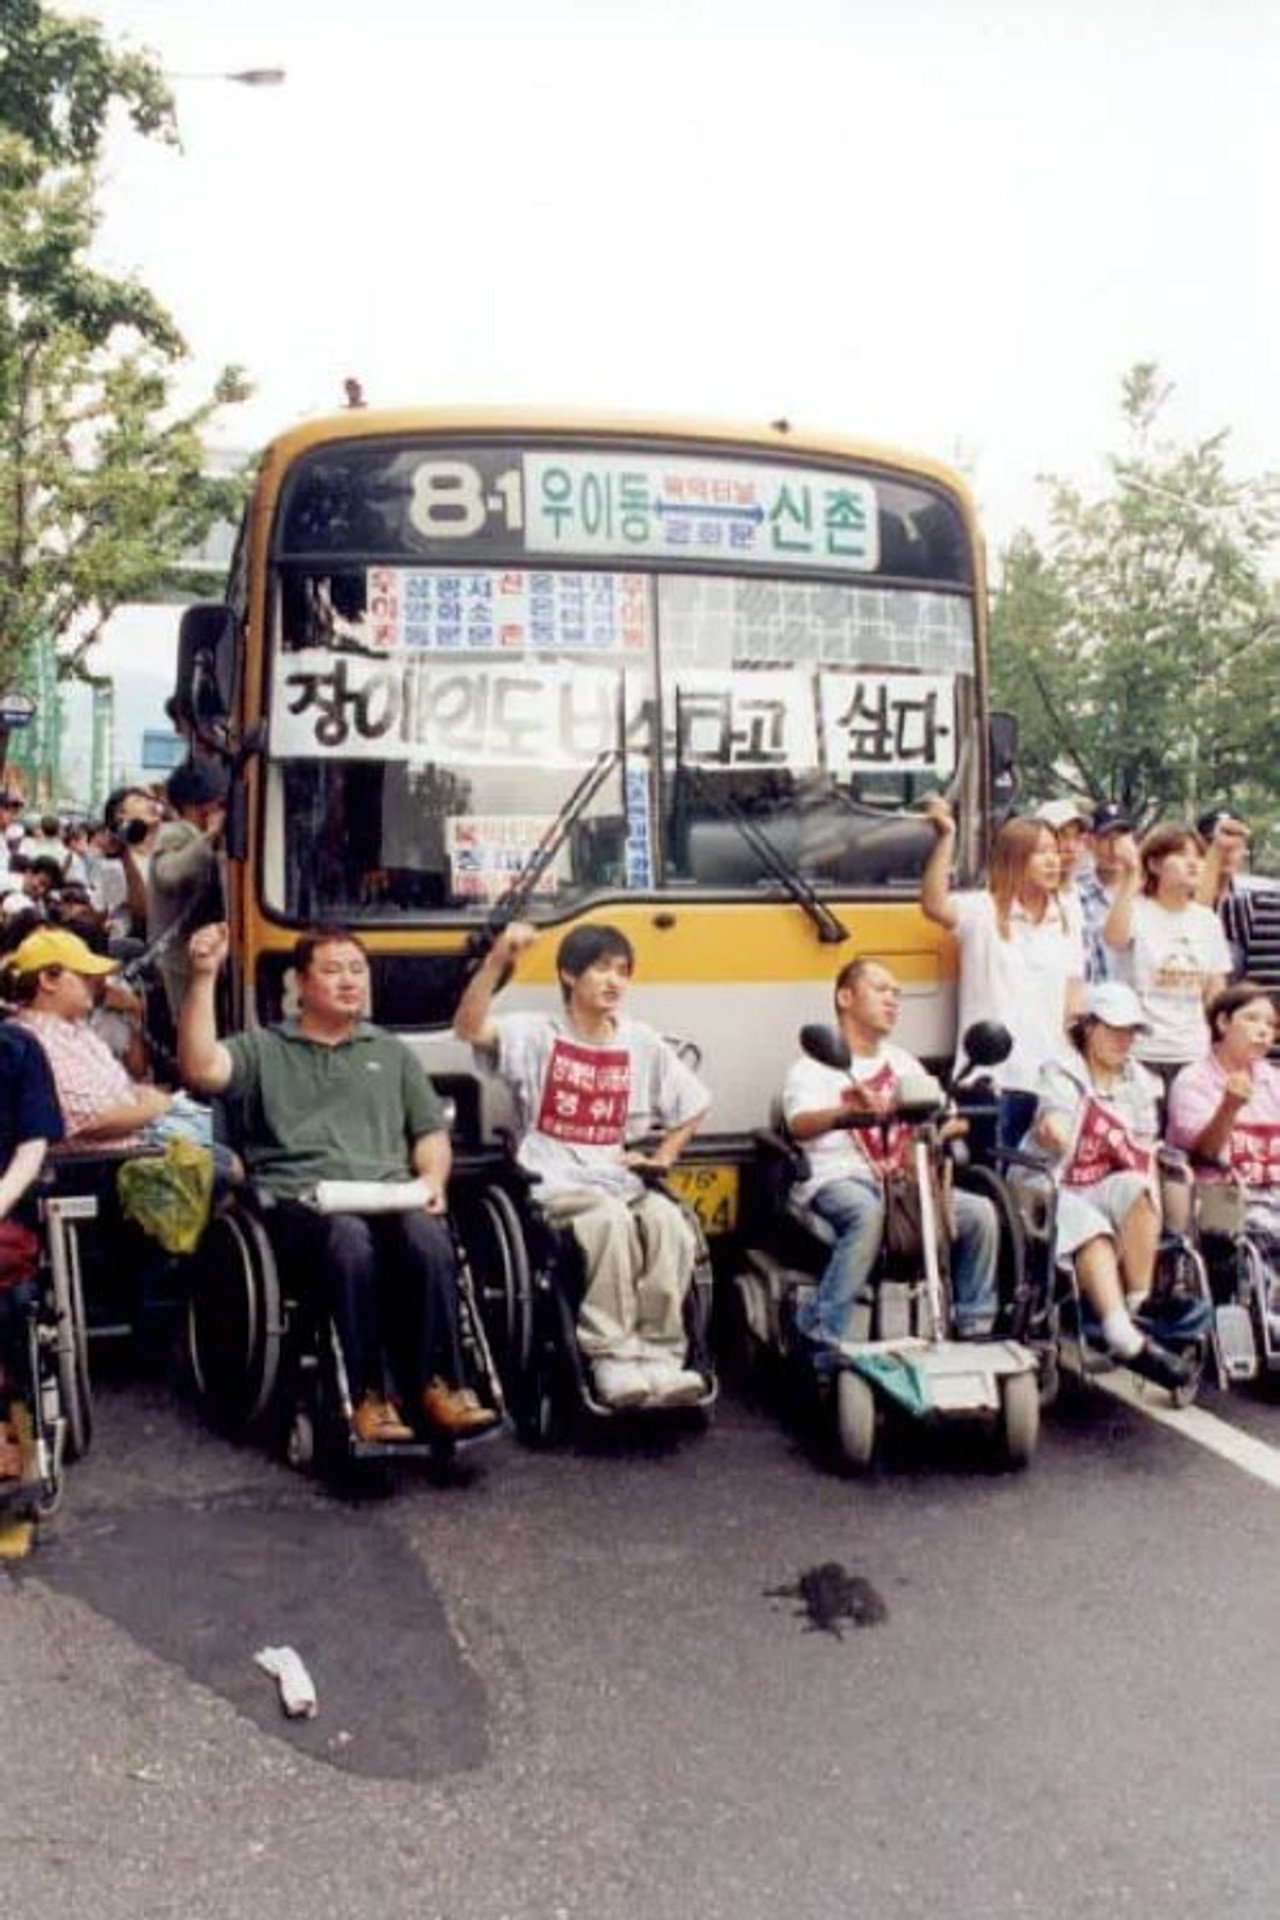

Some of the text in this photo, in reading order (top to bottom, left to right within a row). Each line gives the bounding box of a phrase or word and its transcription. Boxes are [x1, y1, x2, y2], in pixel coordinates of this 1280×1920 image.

[409, 460, 524, 539] 8-1
[540, 467, 653, 544] 우이동
[769, 483, 866, 556] 신촌
[836, 683, 950, 764] 싶다
